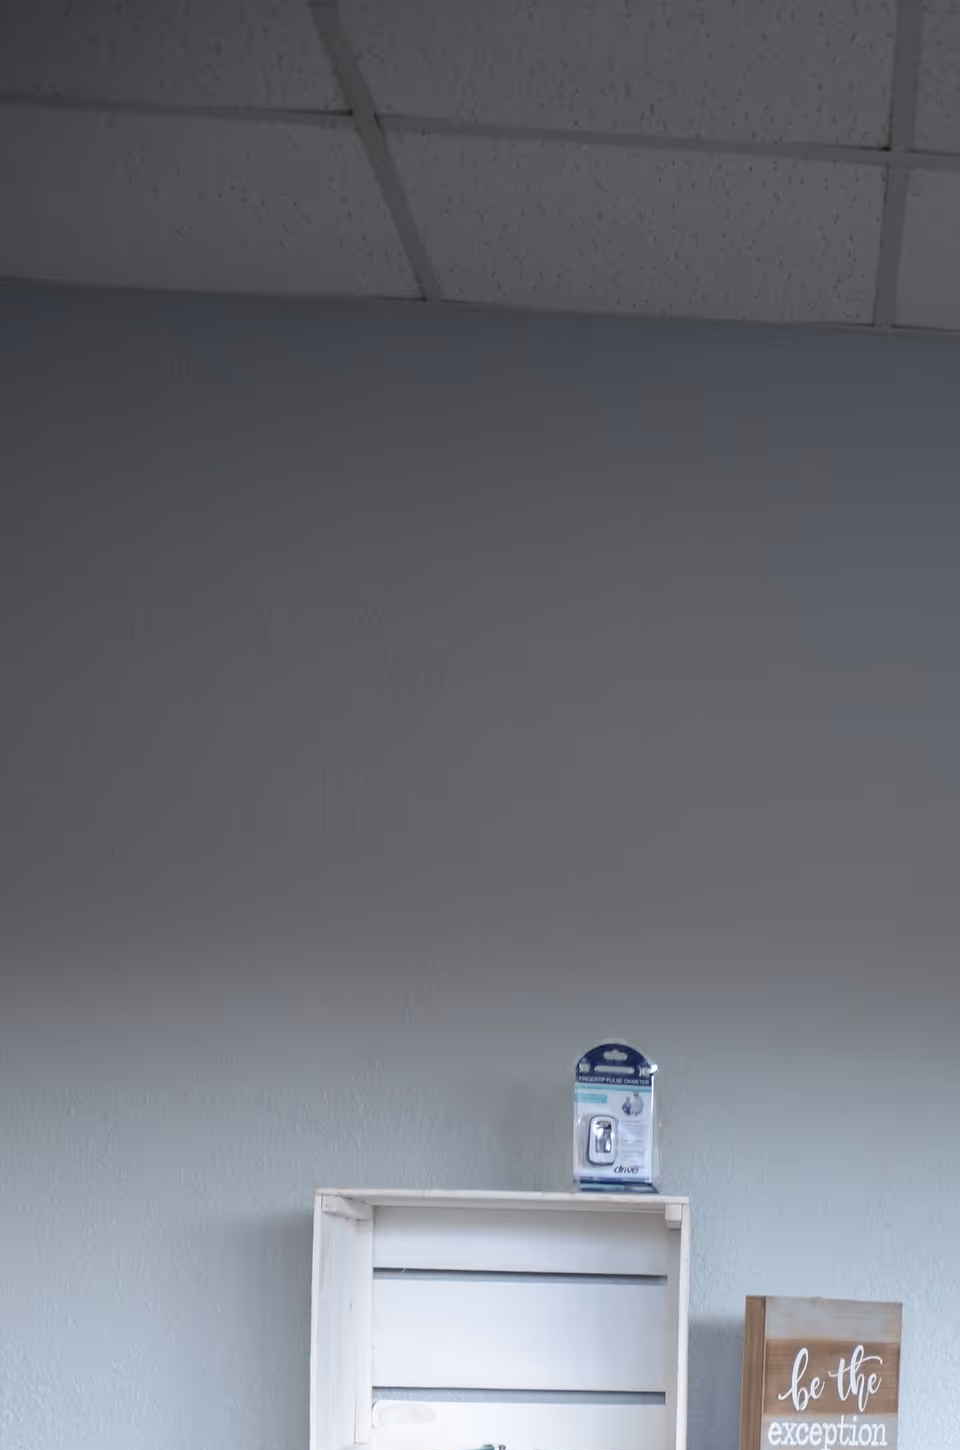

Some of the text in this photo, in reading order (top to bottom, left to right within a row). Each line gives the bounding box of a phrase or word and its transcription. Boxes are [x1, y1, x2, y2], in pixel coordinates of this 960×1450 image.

[613, 1164, 640, 1174] drive
[778, 1344, 883, 1412] be the
